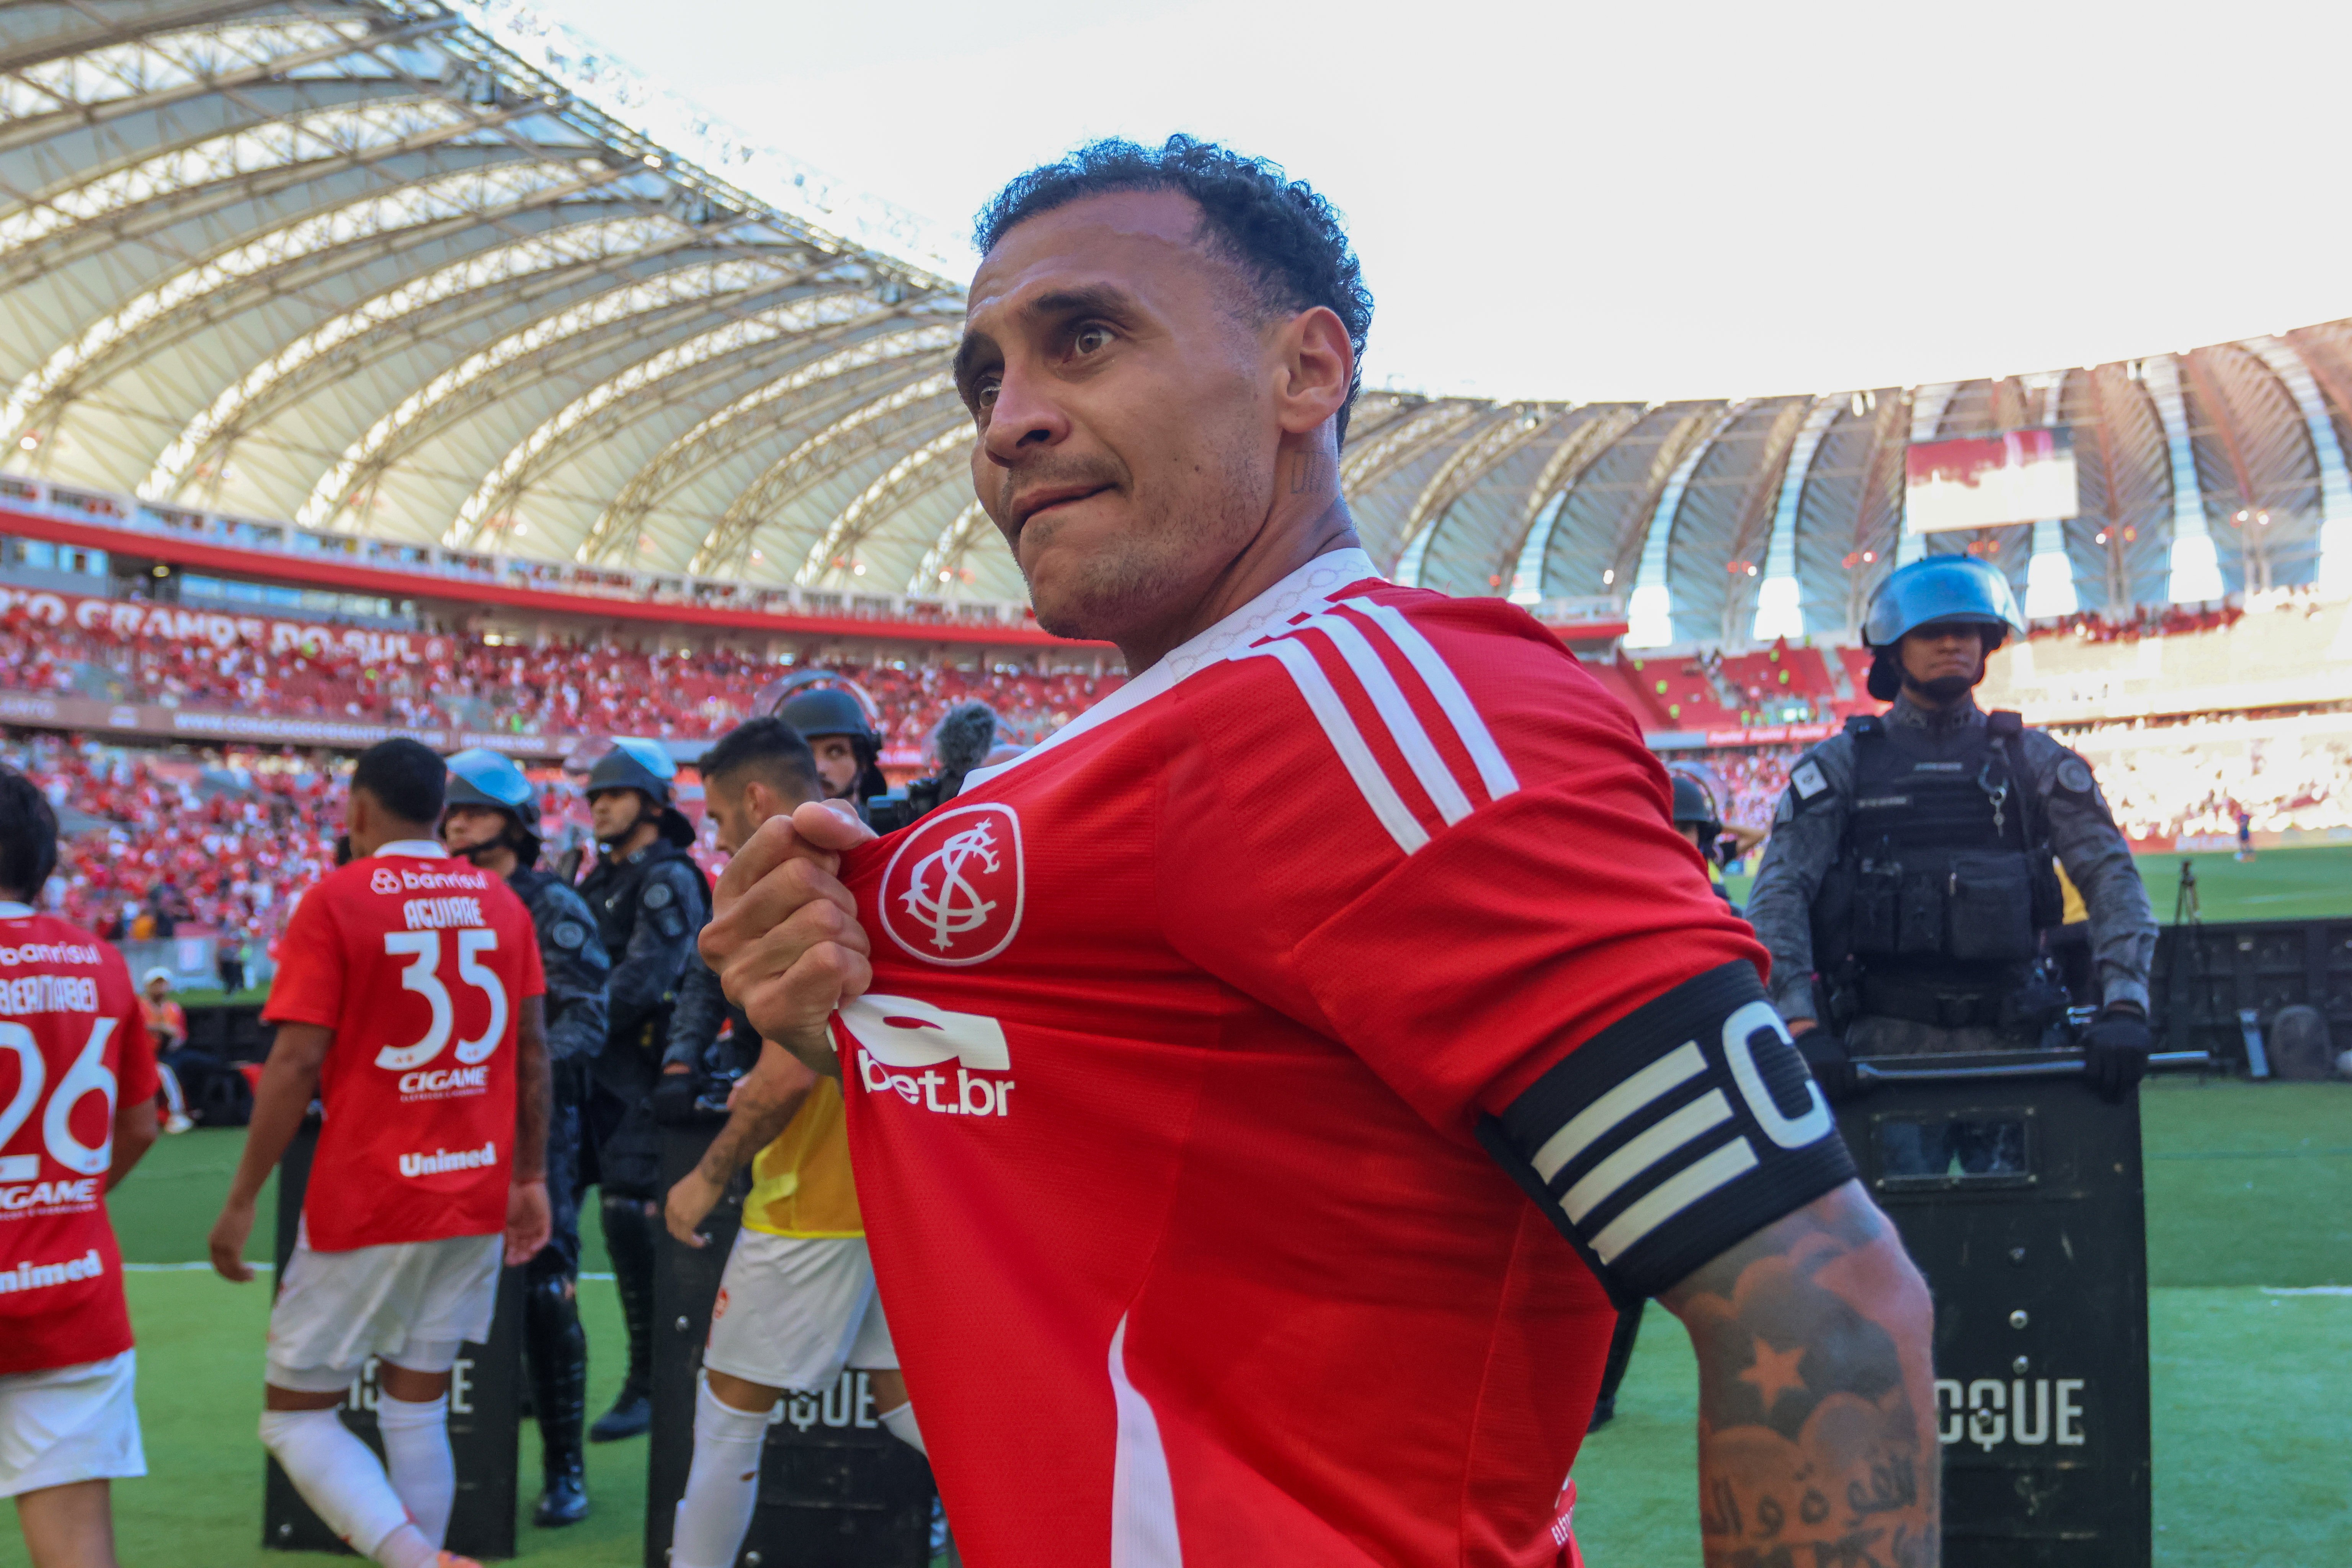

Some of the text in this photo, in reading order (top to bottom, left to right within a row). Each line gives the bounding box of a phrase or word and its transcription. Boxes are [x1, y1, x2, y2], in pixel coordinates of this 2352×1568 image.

[401, 868, 489, 890] banrisul
[403, 896, 487, 930] AGUIRRE
[374, 929, 509, 1071] 35
[398, 1065, 490, 1094] CIGAME
[858, 1049, 1015, 1117] bet.br
[1722, 1000, 1834, 1148] C
[0, 1017, 119, 1183] 26
[399, 1141, 497, 1178] Unimed
[0, 1178, 99, 1210] GAME
